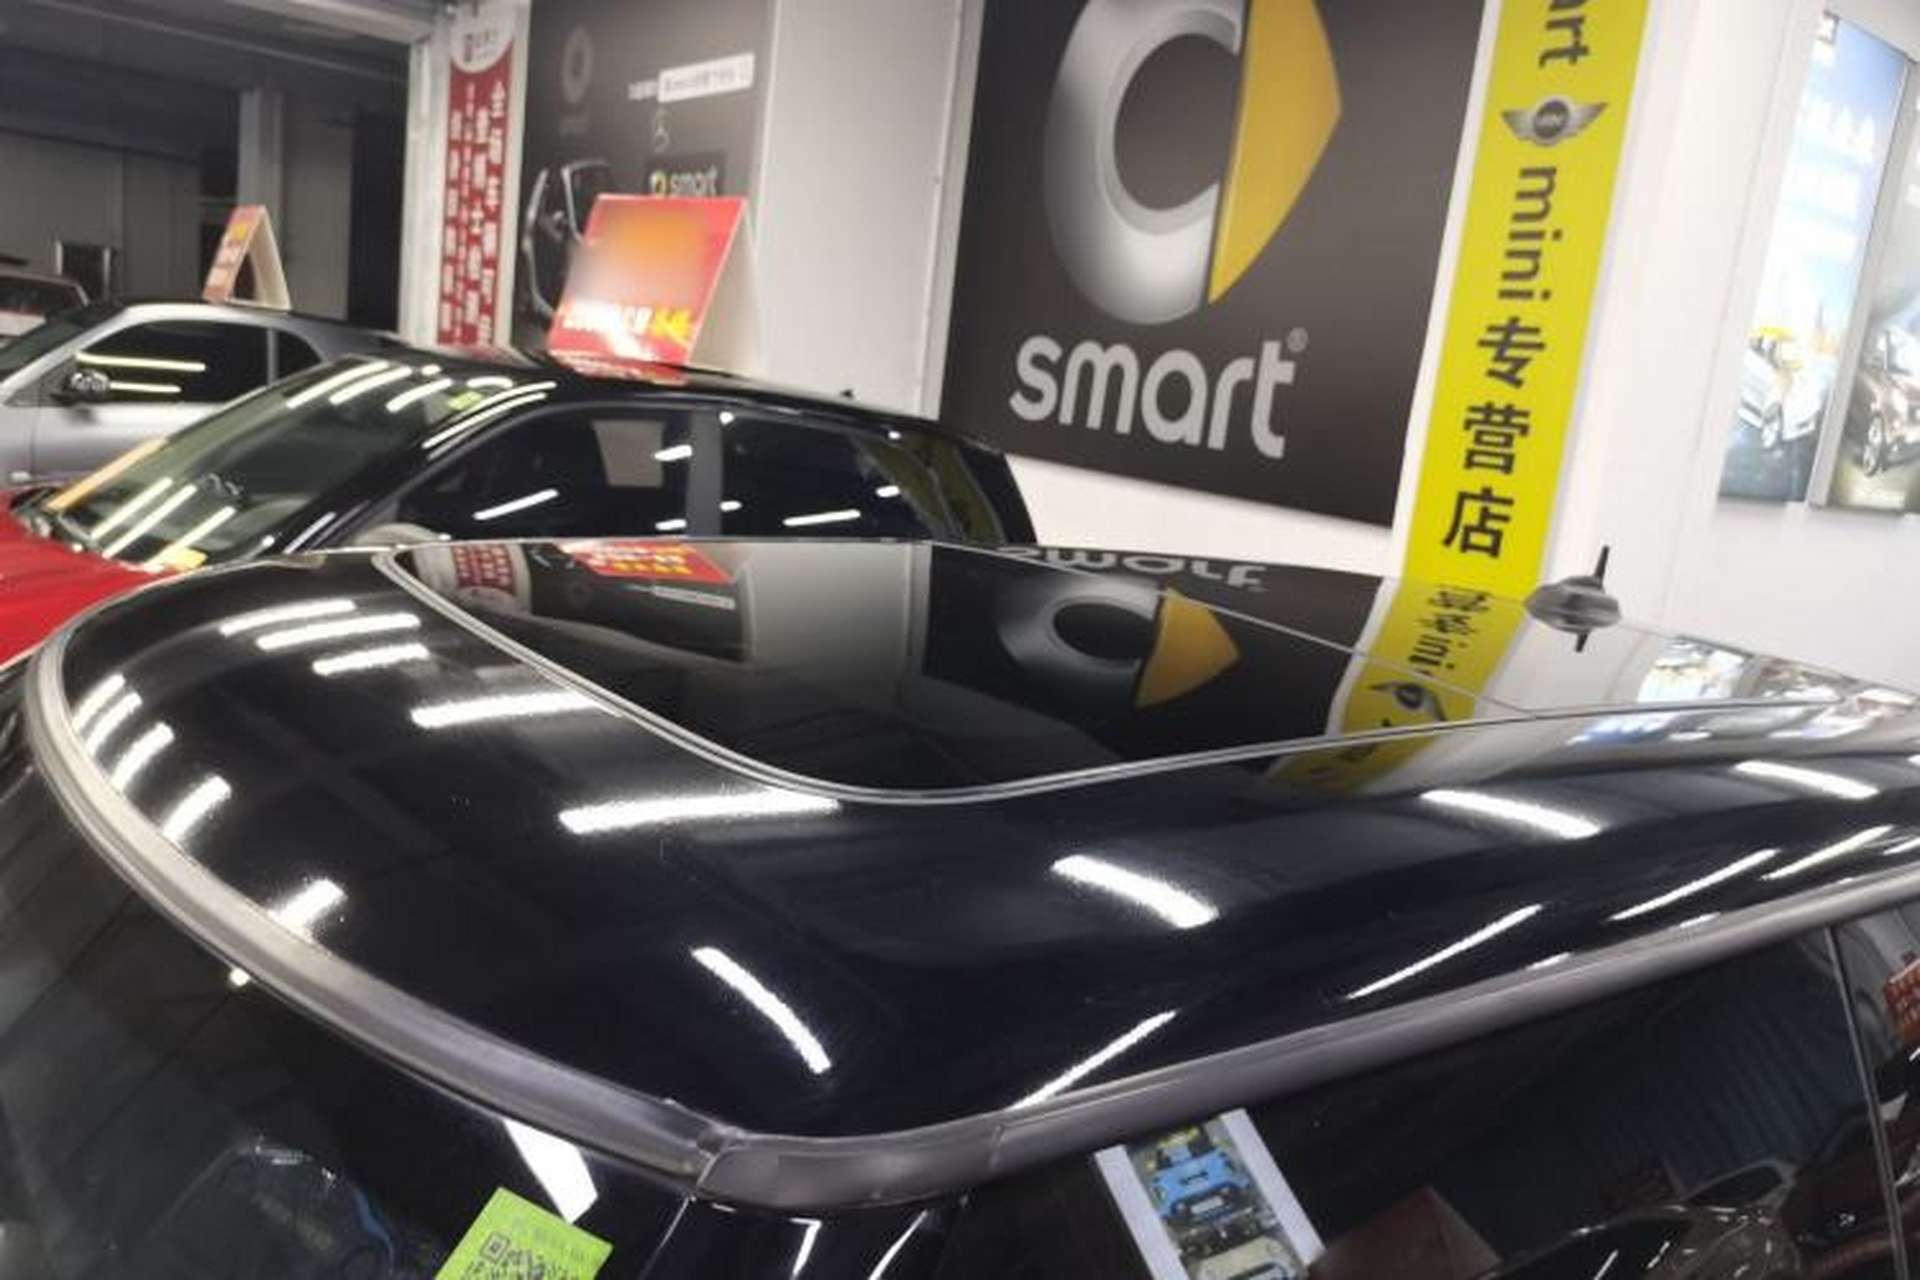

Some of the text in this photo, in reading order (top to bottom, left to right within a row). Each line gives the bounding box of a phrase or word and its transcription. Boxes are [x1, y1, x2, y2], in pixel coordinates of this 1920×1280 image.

[1497, 166, 1563, 301] mini
[1009, 335, 1296, 459] smart
[1441, 316, 1546, 558] 专营店
